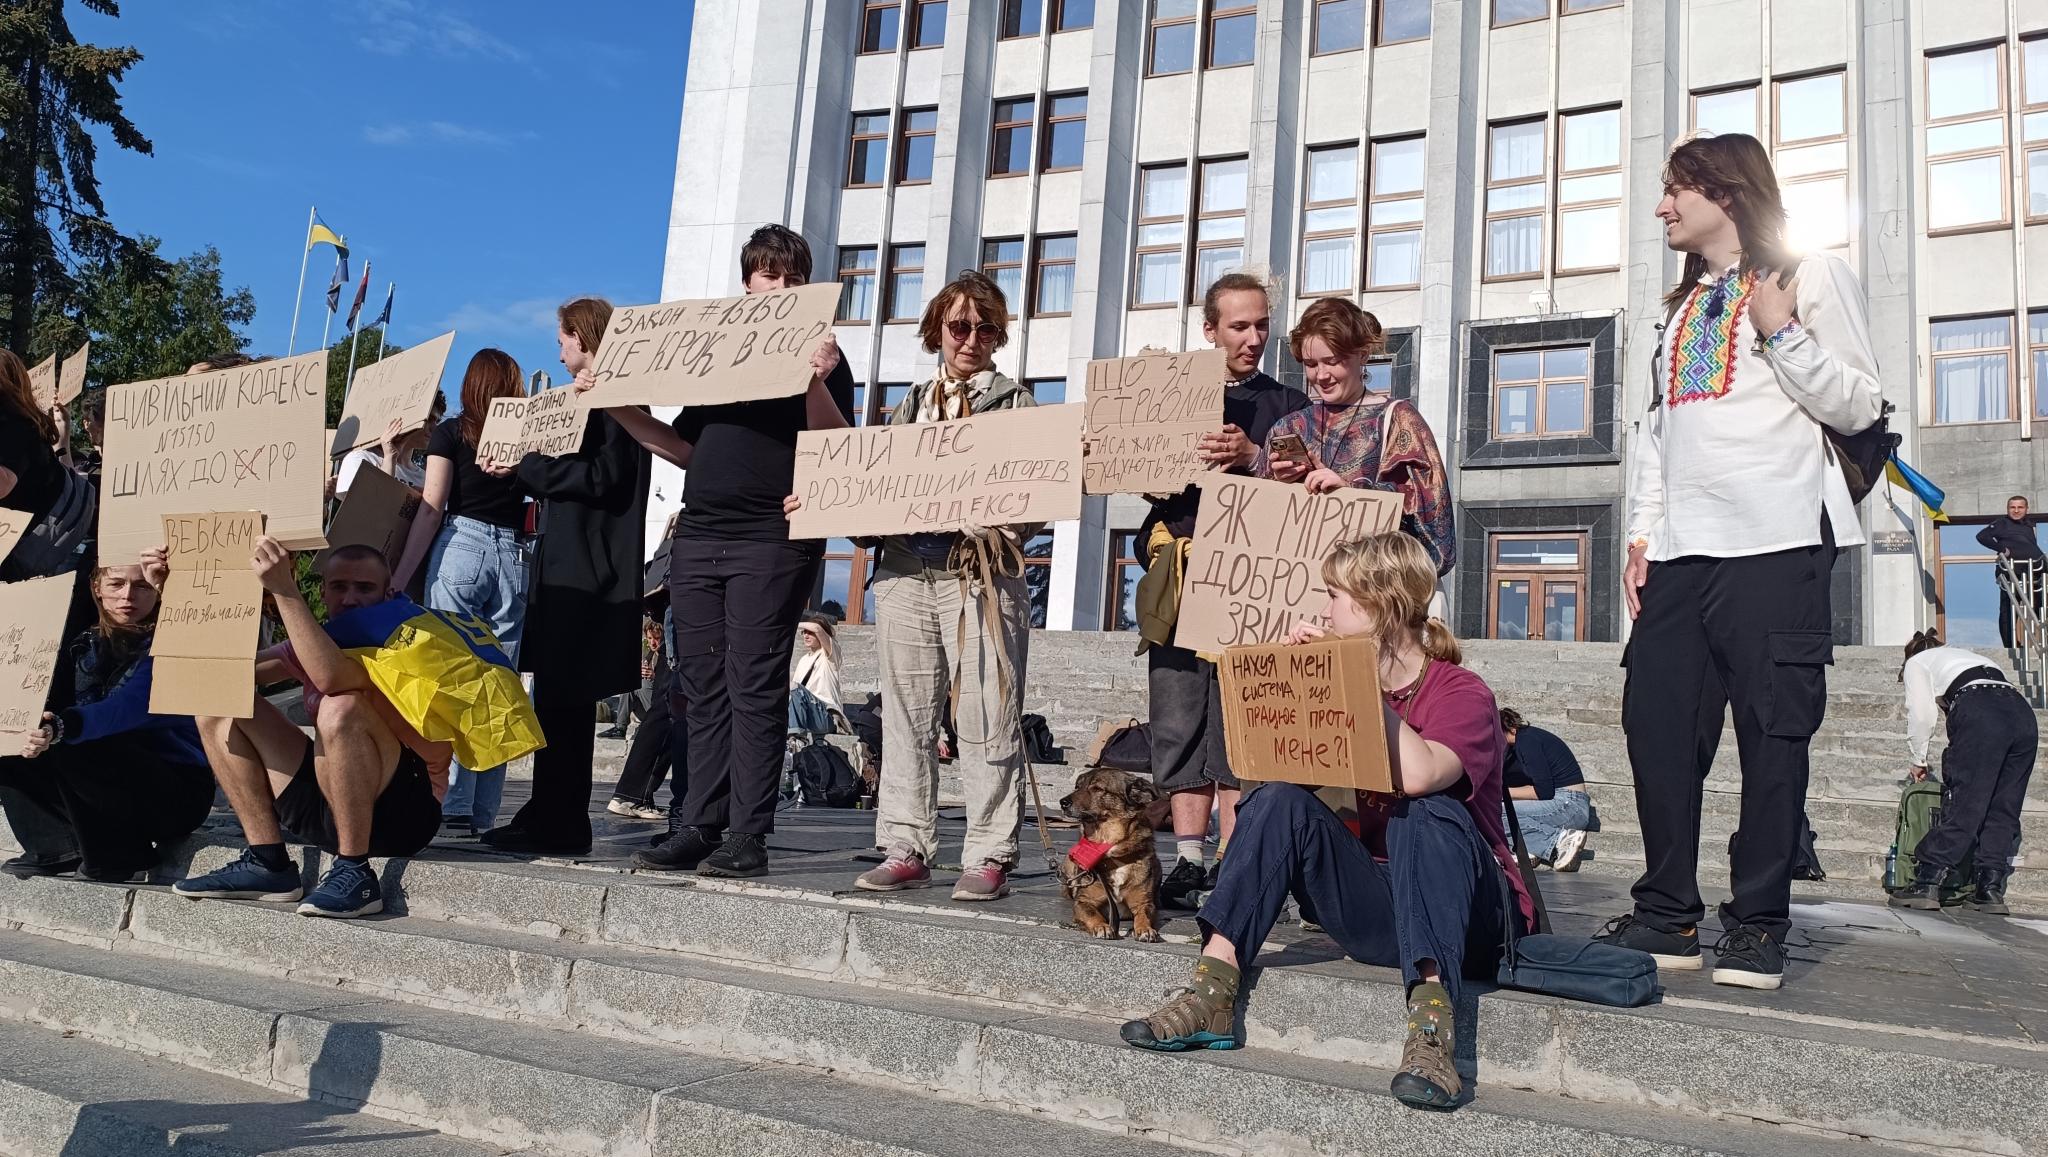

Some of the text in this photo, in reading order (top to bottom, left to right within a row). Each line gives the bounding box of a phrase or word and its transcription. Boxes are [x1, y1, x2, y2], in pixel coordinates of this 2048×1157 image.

[614, 292, 798, 334] ЗАКОН #15150
[595, 320, 827, 382] ЦЕ КРОК В СССР
[1093, 355, 1194, 394] ЩО ЗА
[111, 373, 228, 430] ЦИВІЛЬНИЙ
[237, 362, 319, 408] КОДЕКС
[1091, 381, 1221, 433] СТРЬОМНІ
[915, 423, 974, 461] ПЕС
[1182, 431, 1213, 450] ТУ
[112, 457, 185, 498] ШЛЯХ
[188, 451, 226, 489] ДО
[268, 441, 296, 481] РФ
[805, 459, 1070, 511] РОЗУМНІШИЙ АВТОРІВ
[904, 492, 1031, 524] КОДЕКСУ
[1203, 483, 1398, 561] ЯК МІРЯТИ
[166, 516, 253, 559] ВЕБКАМ
[192, 558, 222, 595] ЦЕ
[1192, 550, 1326, 607] ДОБРО-
[1232, 653, 1278, 680] НАХУЯ
[1246, 705, 1356, 734] ПРАЦЮЄ ПРОТИ
